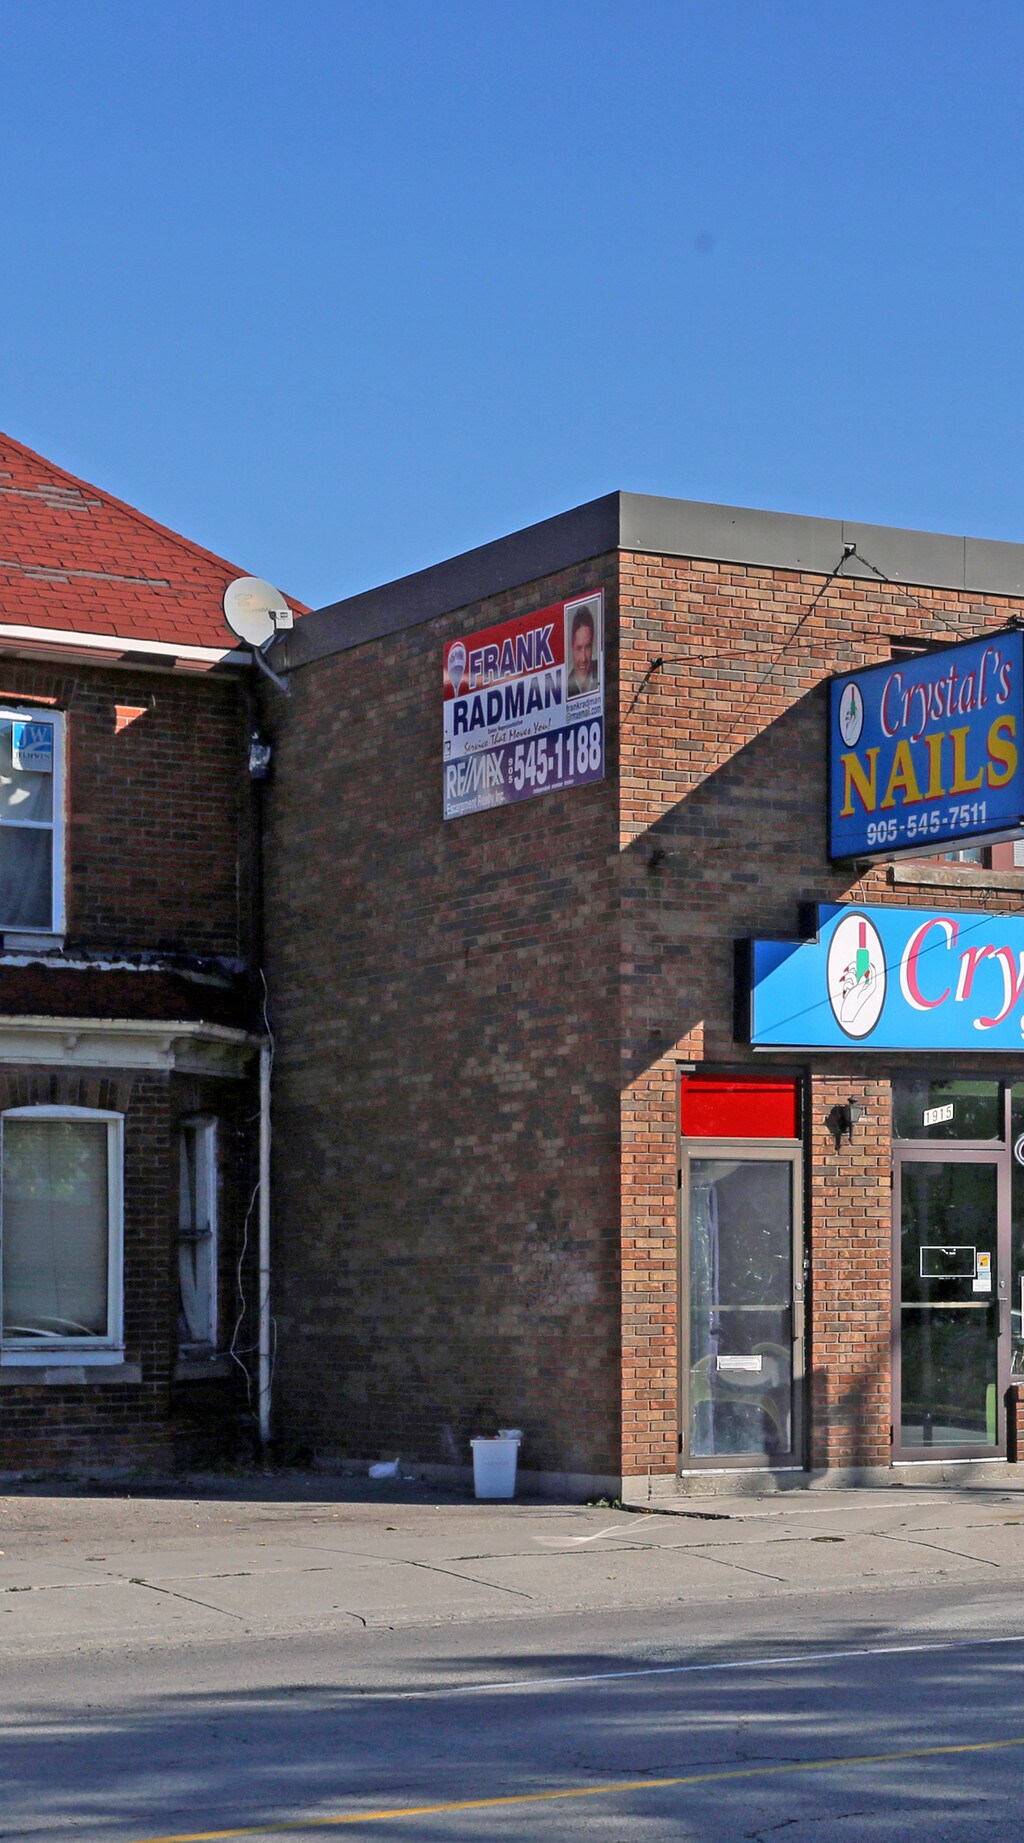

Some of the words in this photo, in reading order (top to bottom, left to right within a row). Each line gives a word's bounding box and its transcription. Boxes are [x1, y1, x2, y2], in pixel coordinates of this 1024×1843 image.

[469, 623, 554, 690] FRANK
[453, 669, 562, 736] RADMAN
[881, 645, 1014, 744] Crystal's
[464, 740, 489, 754] Service
[490, 732, 507, 745] That
[509, 727, 531, 740] Moves
[533, 718, 551, 734] You!
[514, 722, 601, 791] 545-1188
[839, 714, 1019, 819] NAILS
[446, 750, 505, 799] RE/MAX
[867, 801, 987, 846] 905-545-7511
[926, 1105, 953, 1124] 1915
